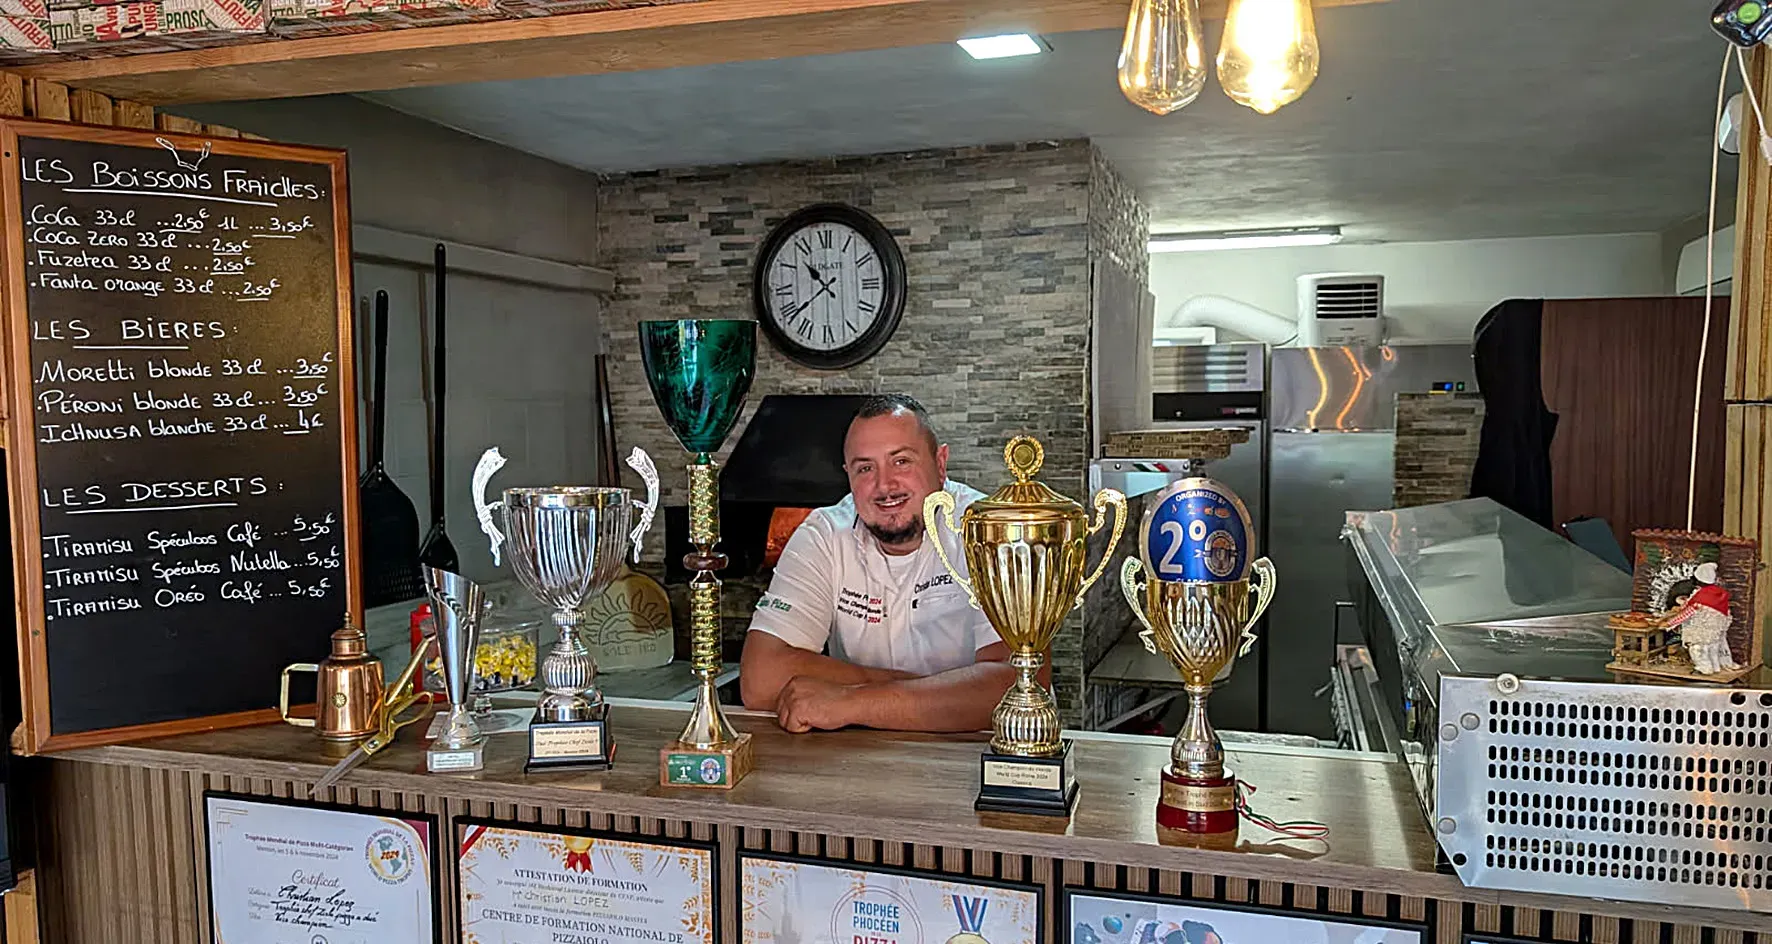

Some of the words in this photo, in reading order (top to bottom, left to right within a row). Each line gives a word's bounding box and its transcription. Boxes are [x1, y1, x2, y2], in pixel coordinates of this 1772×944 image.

[21, 157, 74, 184] LES
[90, 161, 212, 190] BOISSONS
[39, 273, 98, 290] Fanta
[34, 320, 91, 340] LES
[148, 358, 212, 378] blonde
[133, 390, 202, 411] blonde
[43, 485, 106, 507] LES
[121, 477, 267, 503] DESSERTS
[1175, 490, 1217, 503] ORGANIZED
[227, 521, 262, 548] Café
[230, 550, 292, 573] Nutella
[931, 574, 953, 587] LOPEZ
[220, 580, 263, 605] Café
[291, 869, 340, 890] Certificat
[513, 869, 575, 884] ATTESTATION
[577, 875, 590, 885] DE
[591, 877, 648, 892] FORMATION
[573, 896, 609, 908] LOPEZ
[853, 901, 900, 919] TROPHÉE
[482, 908, 522, 923] CENTRE
[525, 914, 540, 925] DE
[541, 916, 607, 933] FORMATION
[608, 924, 666, 941] NATIONAL
[668, 932, 684, 944] DE
[853, 915, 899, 933] PHOCÉEN
